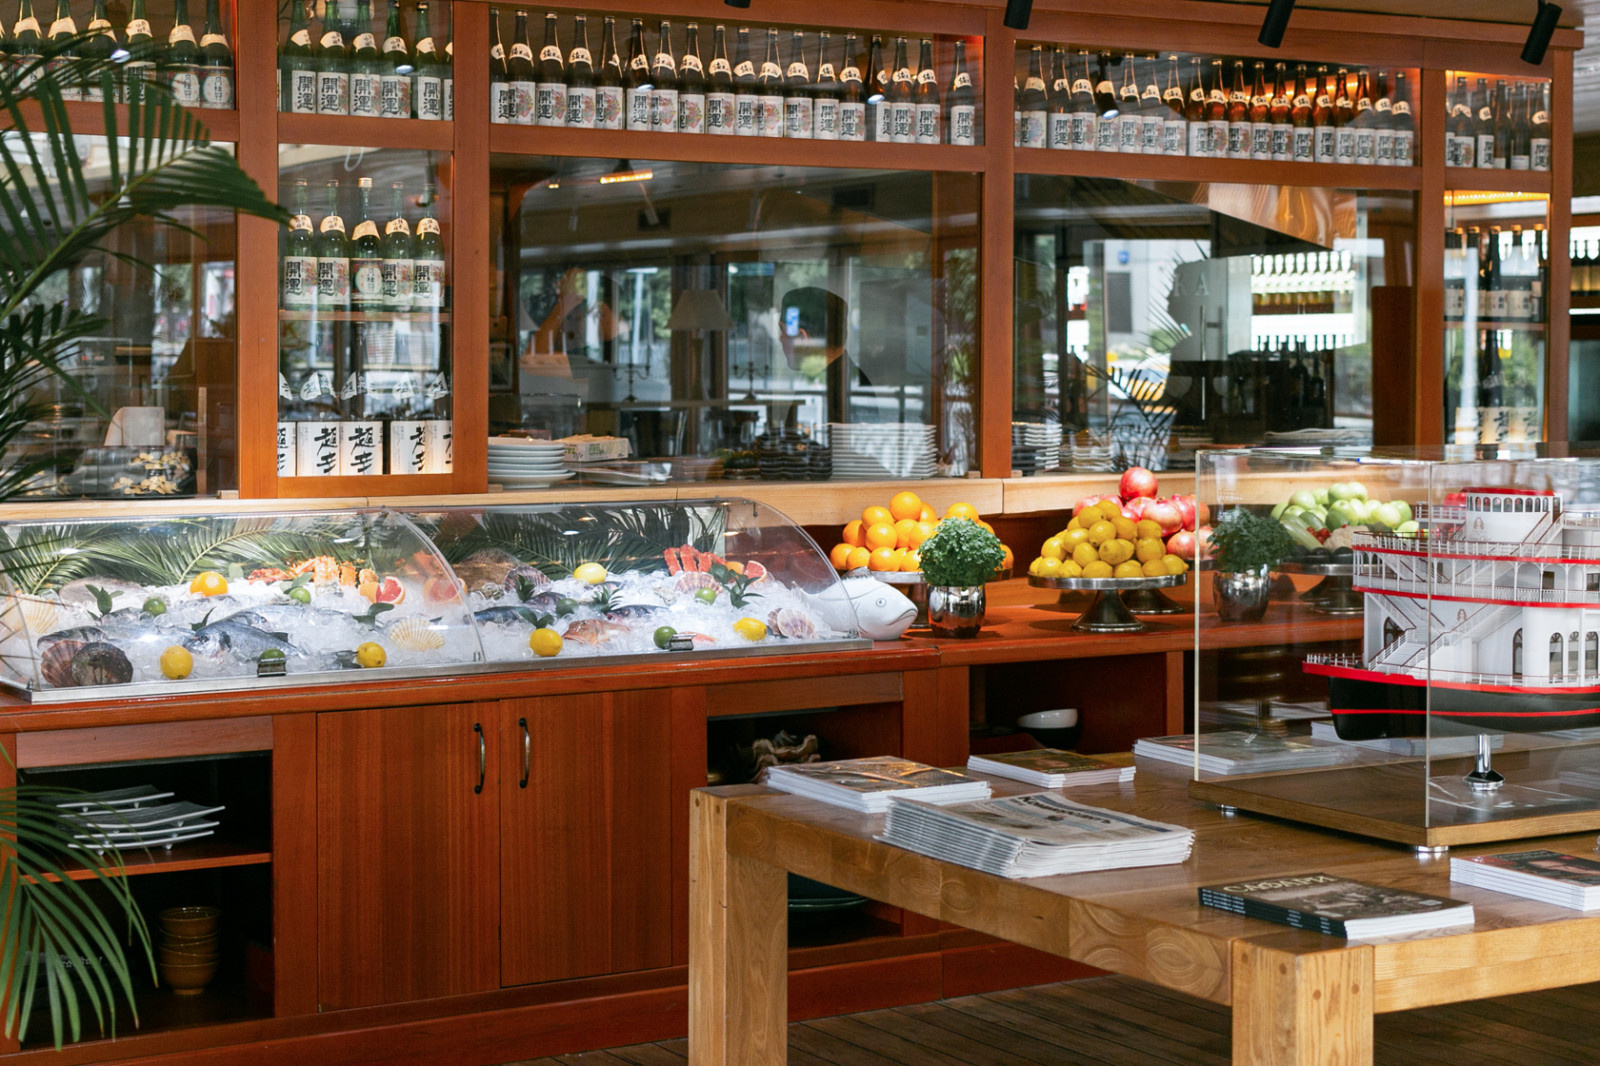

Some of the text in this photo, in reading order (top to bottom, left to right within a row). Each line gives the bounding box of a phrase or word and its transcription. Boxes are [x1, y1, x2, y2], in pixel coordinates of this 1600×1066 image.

[297, 76, 313, 110] 開運
[321, 77, 338, 112] 開運
[353, 79, 371, 113] 開運
[381, 81, 398, 115] 開運
[423, 82, 438, 116] 開運
[538, 90, 552, 119] 開運
[567, 94, 581, 123] 開運
[633, 95, 647, 124] 開運
[707, 99, 722, 128] 開運
[738, 101, 752, 129] 開運
[820, 105, 834, 132] 開運
[841, 109, 855, 136] 開運
[894, 109, 909, 136] 開運
[919, 110, 933, 137] 開運
[956, 112, 970, 139] 開運
[1054, 119, 1068, 145] 開運
[1098, 121, 1112, 147] 開運
[1121, 121, 1135, 147] 開運
[1142, 122, 1156, 148] 開運
[1163, 126, 1177, 152] 開運
[286, 261, 302, 296] 開運
[318, 262, 334, 296] 開運
[383, 263, 398, 297] 開運
[1223, 875, 1338, 893] САФАРИ
